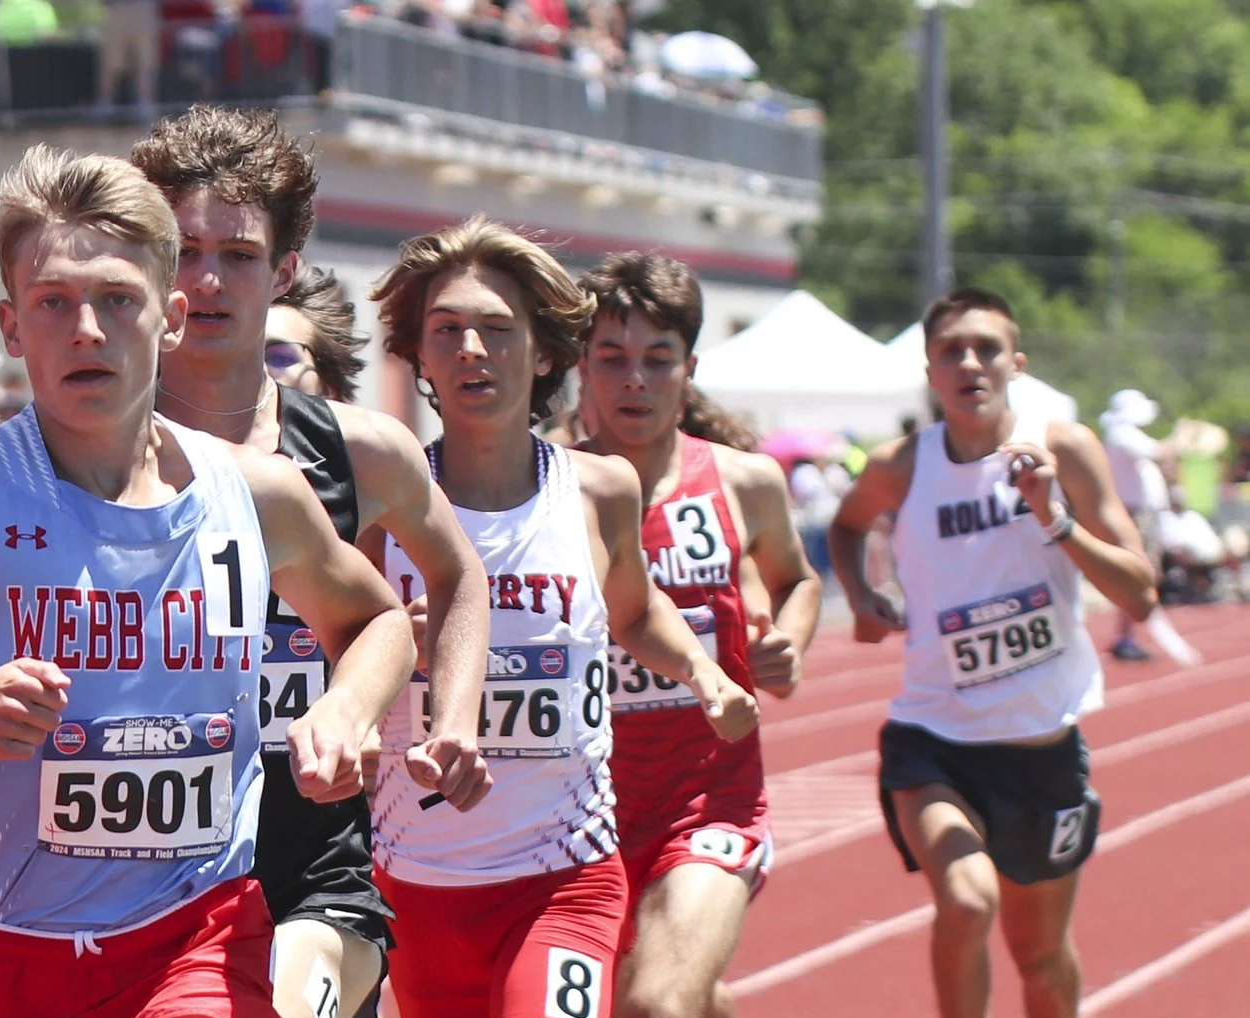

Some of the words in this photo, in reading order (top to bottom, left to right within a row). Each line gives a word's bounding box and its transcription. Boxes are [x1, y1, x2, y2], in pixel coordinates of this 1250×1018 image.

[677, 505, 716, 560] 3
[937, 494, 1008, 538] ROLL
[212, 540, 244, 628] 1
[7, 585, 145, 671] WEBB
[953, 615, 1054, 672] 5798
[583, 659, 605, 728] 8
[102, 725, 193, 753] ZERO
[125, 718, 174, 728] SHOW-ME
[53, 765, 214, 835] 5901
[73, 847, 106, 857] MSHSAA
[111, 848, 132, 858] Track
[136, 849, 151, 858] and
[155, 848, 174, 859] Field
[1057, 812, 1083, 855] 2
